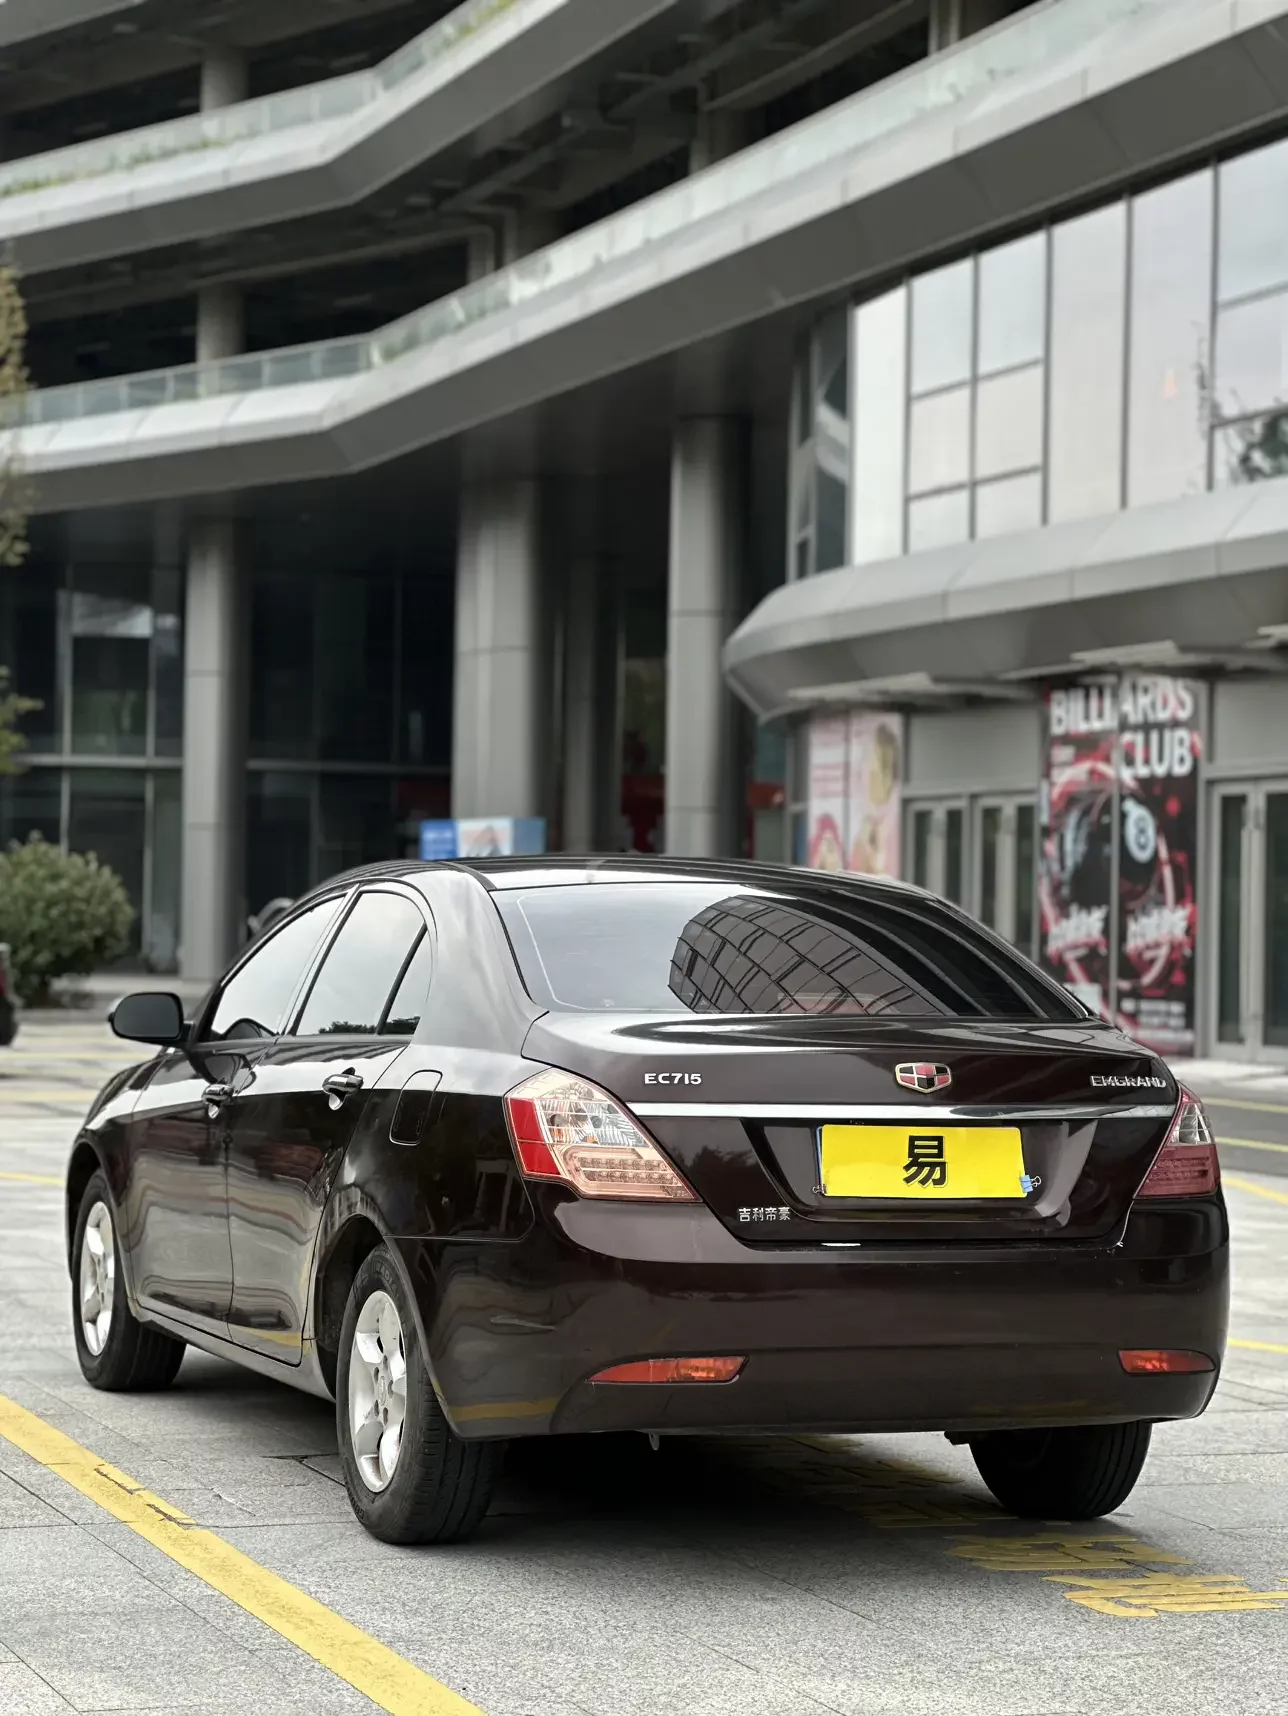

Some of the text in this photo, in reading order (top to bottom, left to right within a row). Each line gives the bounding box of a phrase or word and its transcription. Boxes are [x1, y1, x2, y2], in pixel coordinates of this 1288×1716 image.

[1119, 727, 1194, 780] CLUB
[644, 1073, 702, 1085] EC715
[1090, 1075, 1167, 1088] EMGRAND
[903, 1134, 948, 1188] 易
[738, 1206, 790, 1222] 吉利帝豪
